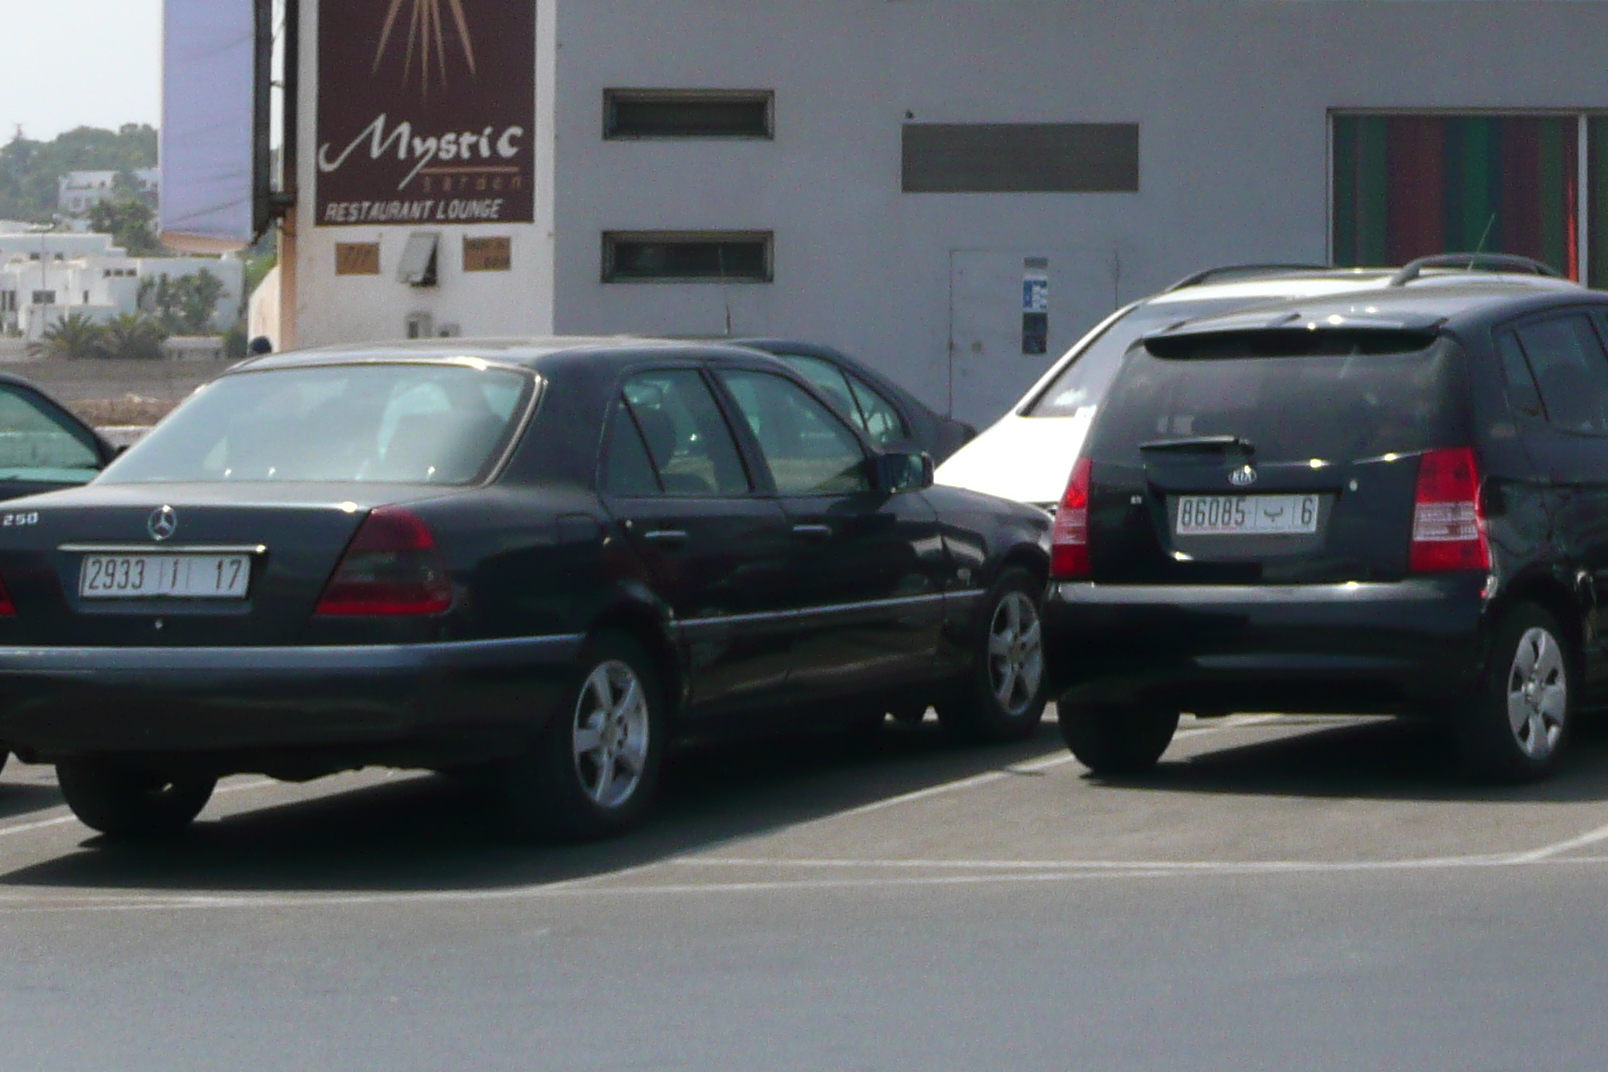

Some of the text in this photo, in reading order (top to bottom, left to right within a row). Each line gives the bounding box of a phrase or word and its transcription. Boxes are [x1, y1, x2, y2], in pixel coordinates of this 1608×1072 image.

[318, 113, 523, 190] Mystic
[326, 199, 503, 222] RESTAURANT LOUNGE
[1181, 497, 1246, 527] 86085
[1301, 497, 1313, 525] 6
[88, 559, 146, 590] 2933
[215, 559, 242, 590] 17
